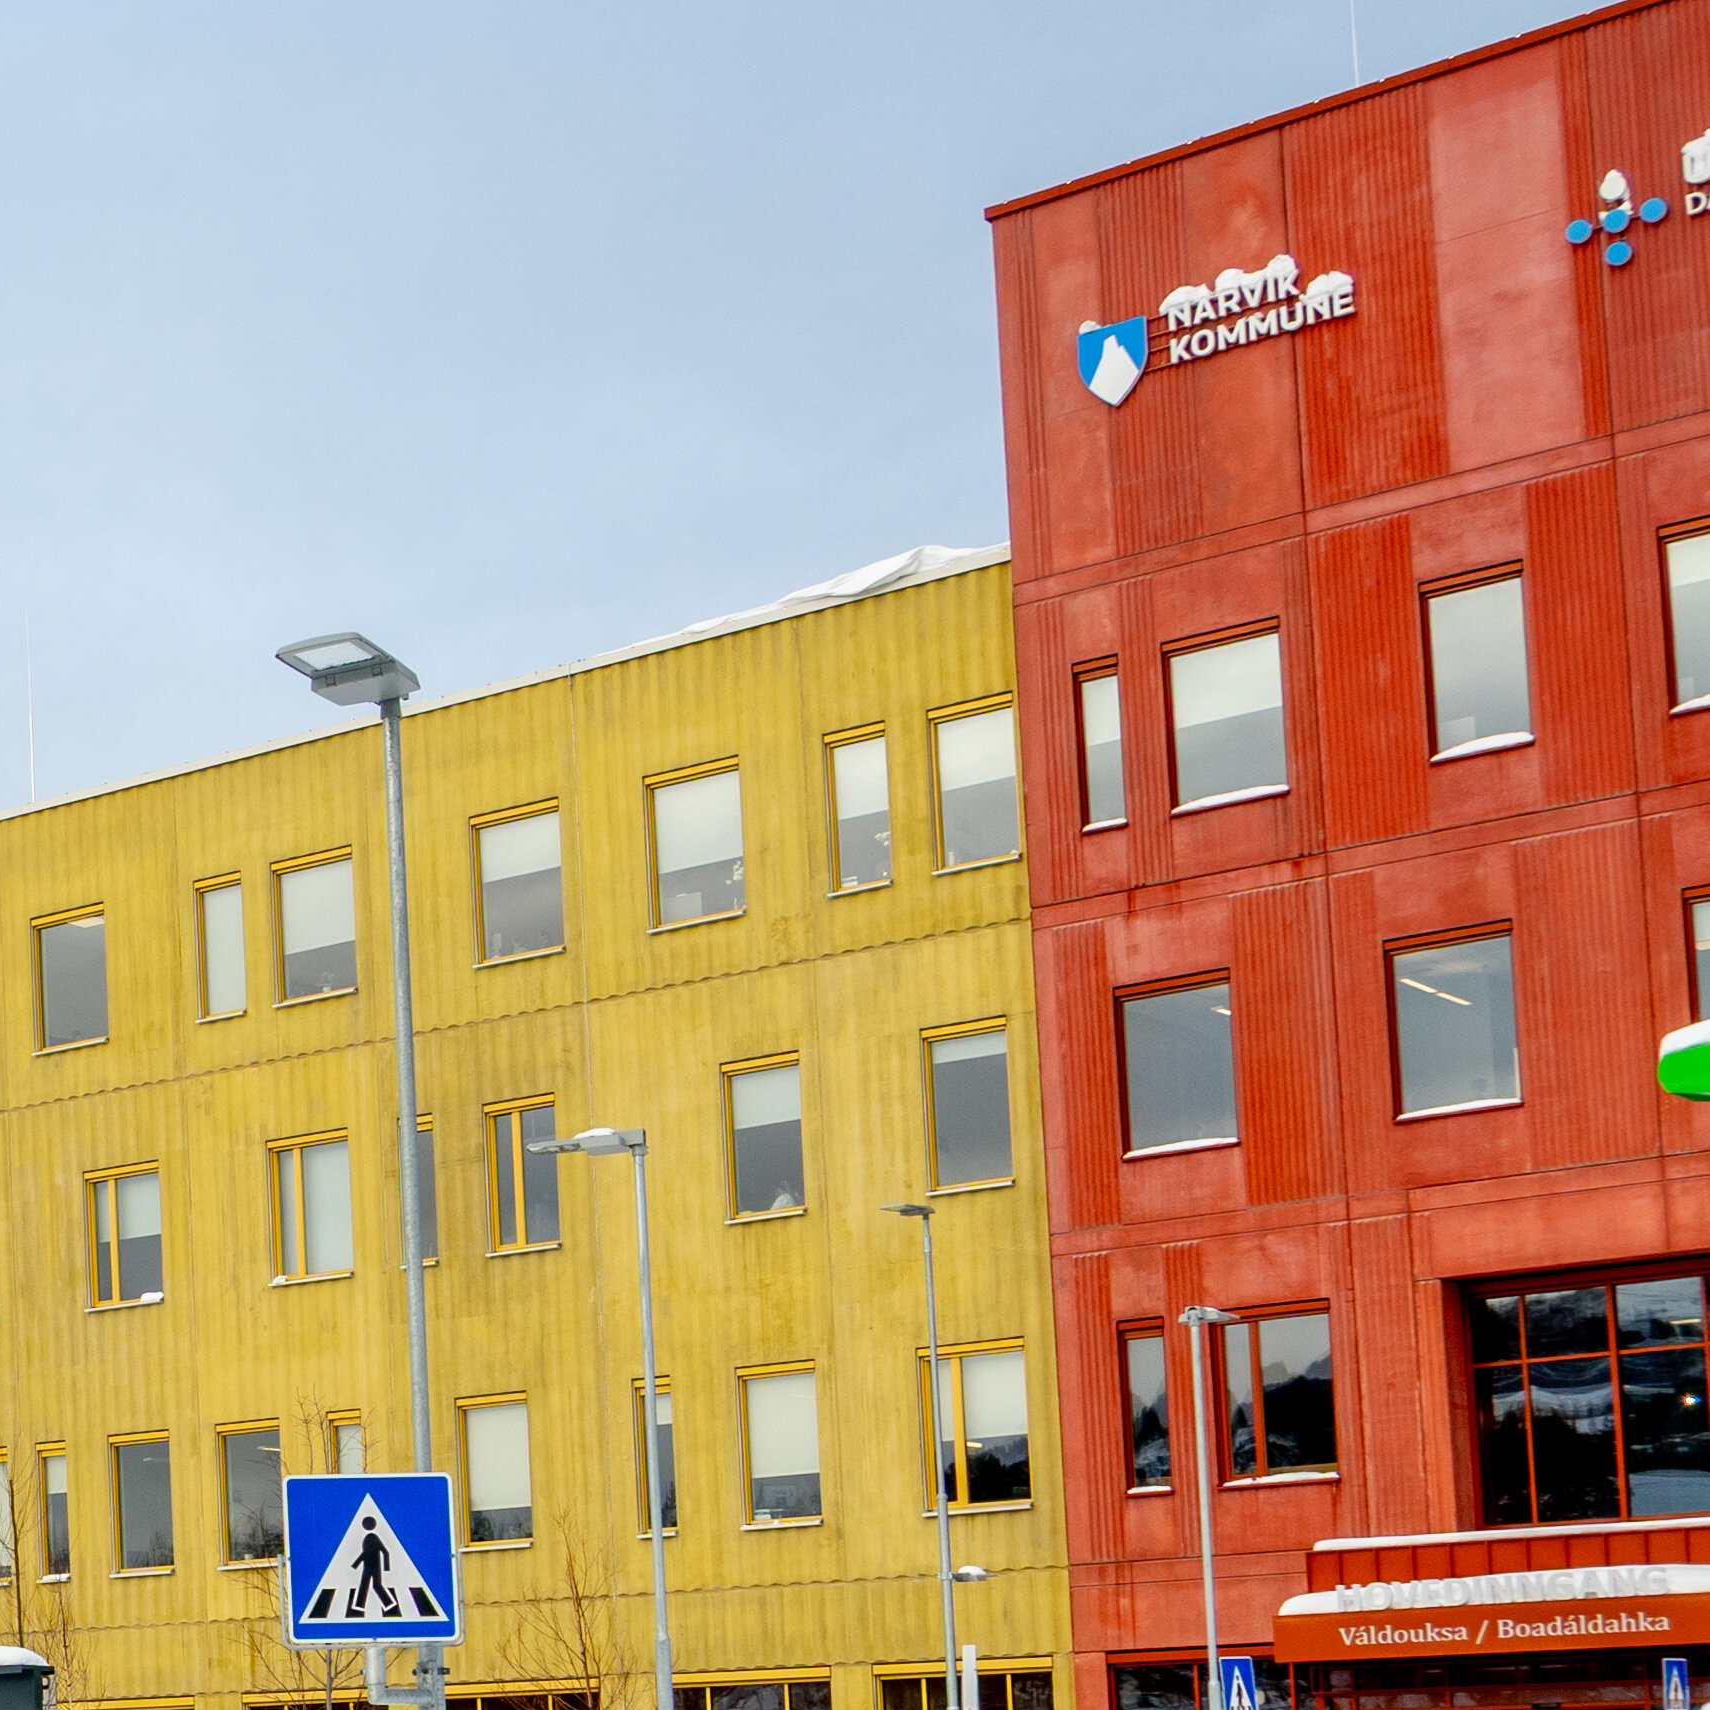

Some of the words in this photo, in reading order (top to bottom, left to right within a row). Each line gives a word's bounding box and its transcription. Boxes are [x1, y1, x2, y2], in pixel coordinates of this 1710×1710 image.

[1166, 268, 1300, 332] NARVIK
[1169, 284, 1356, 364] KOMMUNE
[1335, 1565, 1668, 1612] HOVEDINNGANG
[1339, 1621, 1469, 1646] Váldouksa
[1475, 1620, 1489, 1645] /
[1497, 1611, 1672, 1640] Boadáldahka
